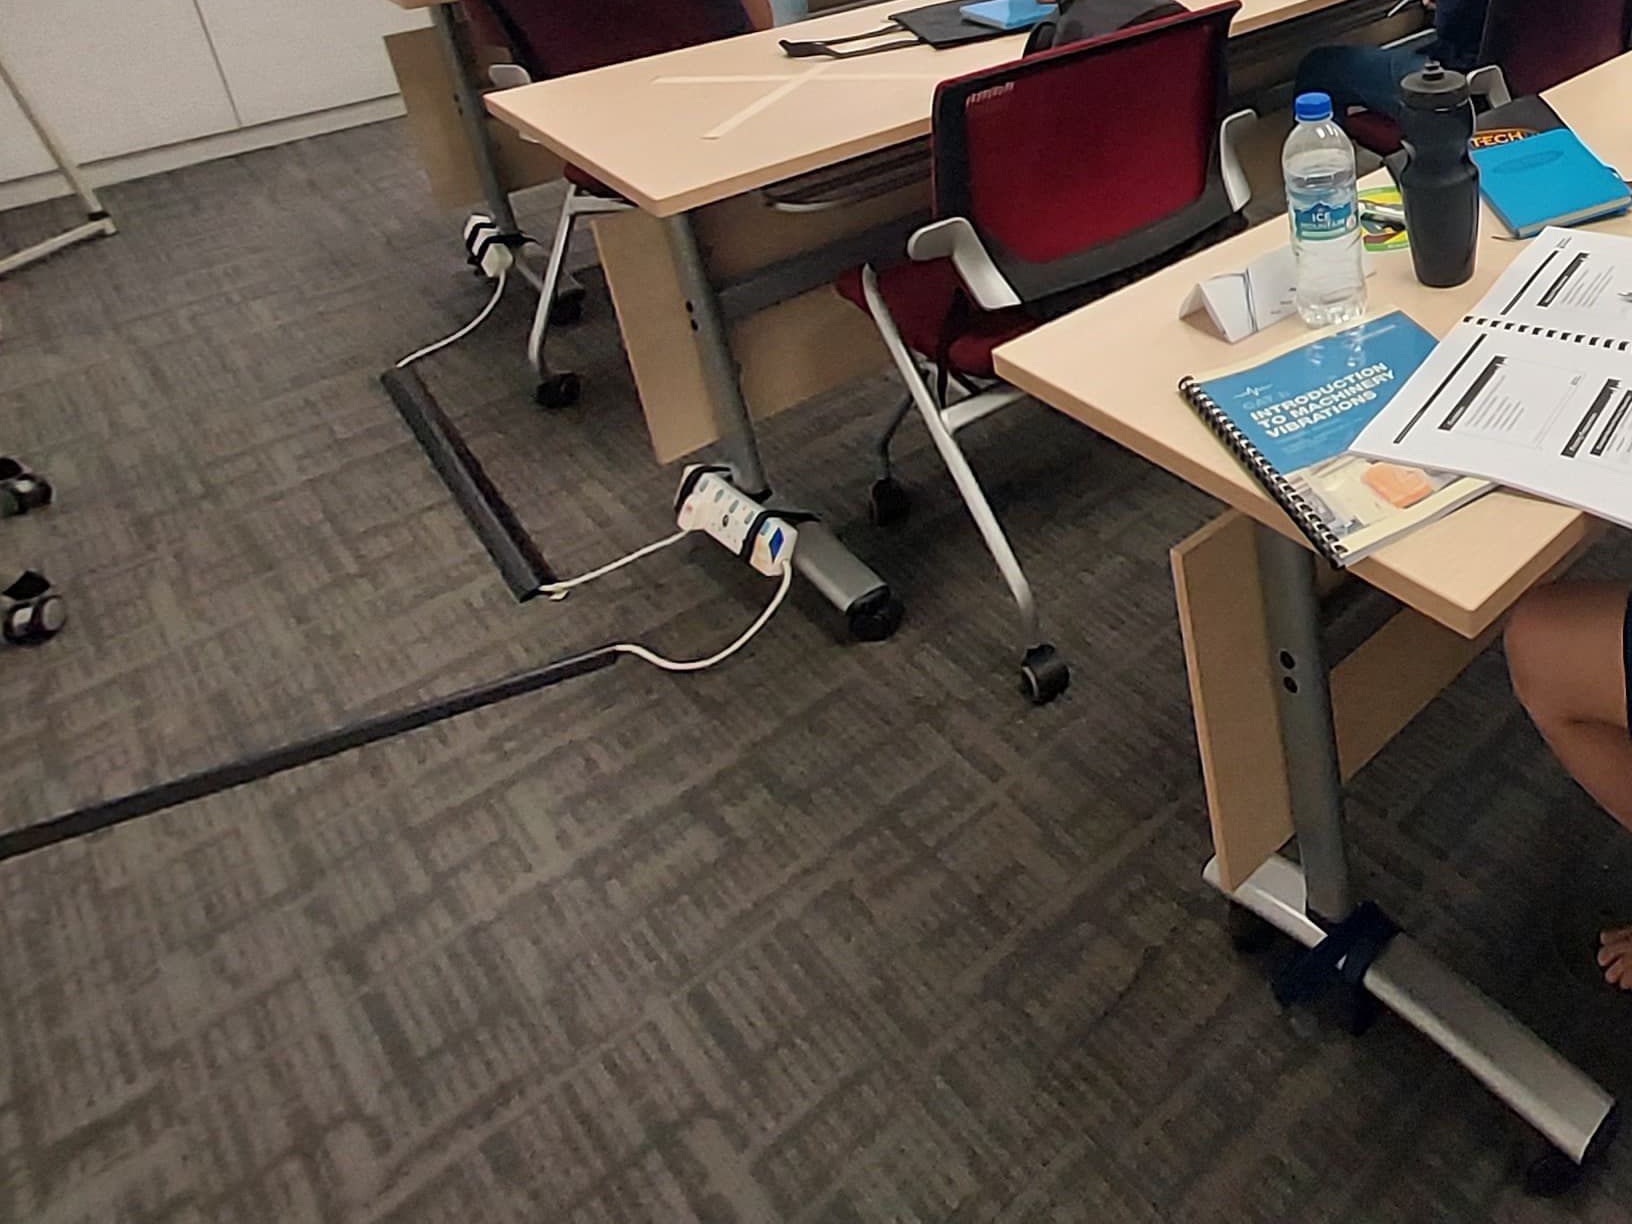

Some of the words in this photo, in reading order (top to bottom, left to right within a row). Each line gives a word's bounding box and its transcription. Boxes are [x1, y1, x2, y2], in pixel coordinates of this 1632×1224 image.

[1471, 130, 1525, 148] TECH
[1250, 361, 1389, 421] INTRODUCTION
[1257, 413, 1287, 429] TO
[1290, 369, 1396, 419] MACHINERY
[1265, 390, 1378, 438] VIBRATIONS
